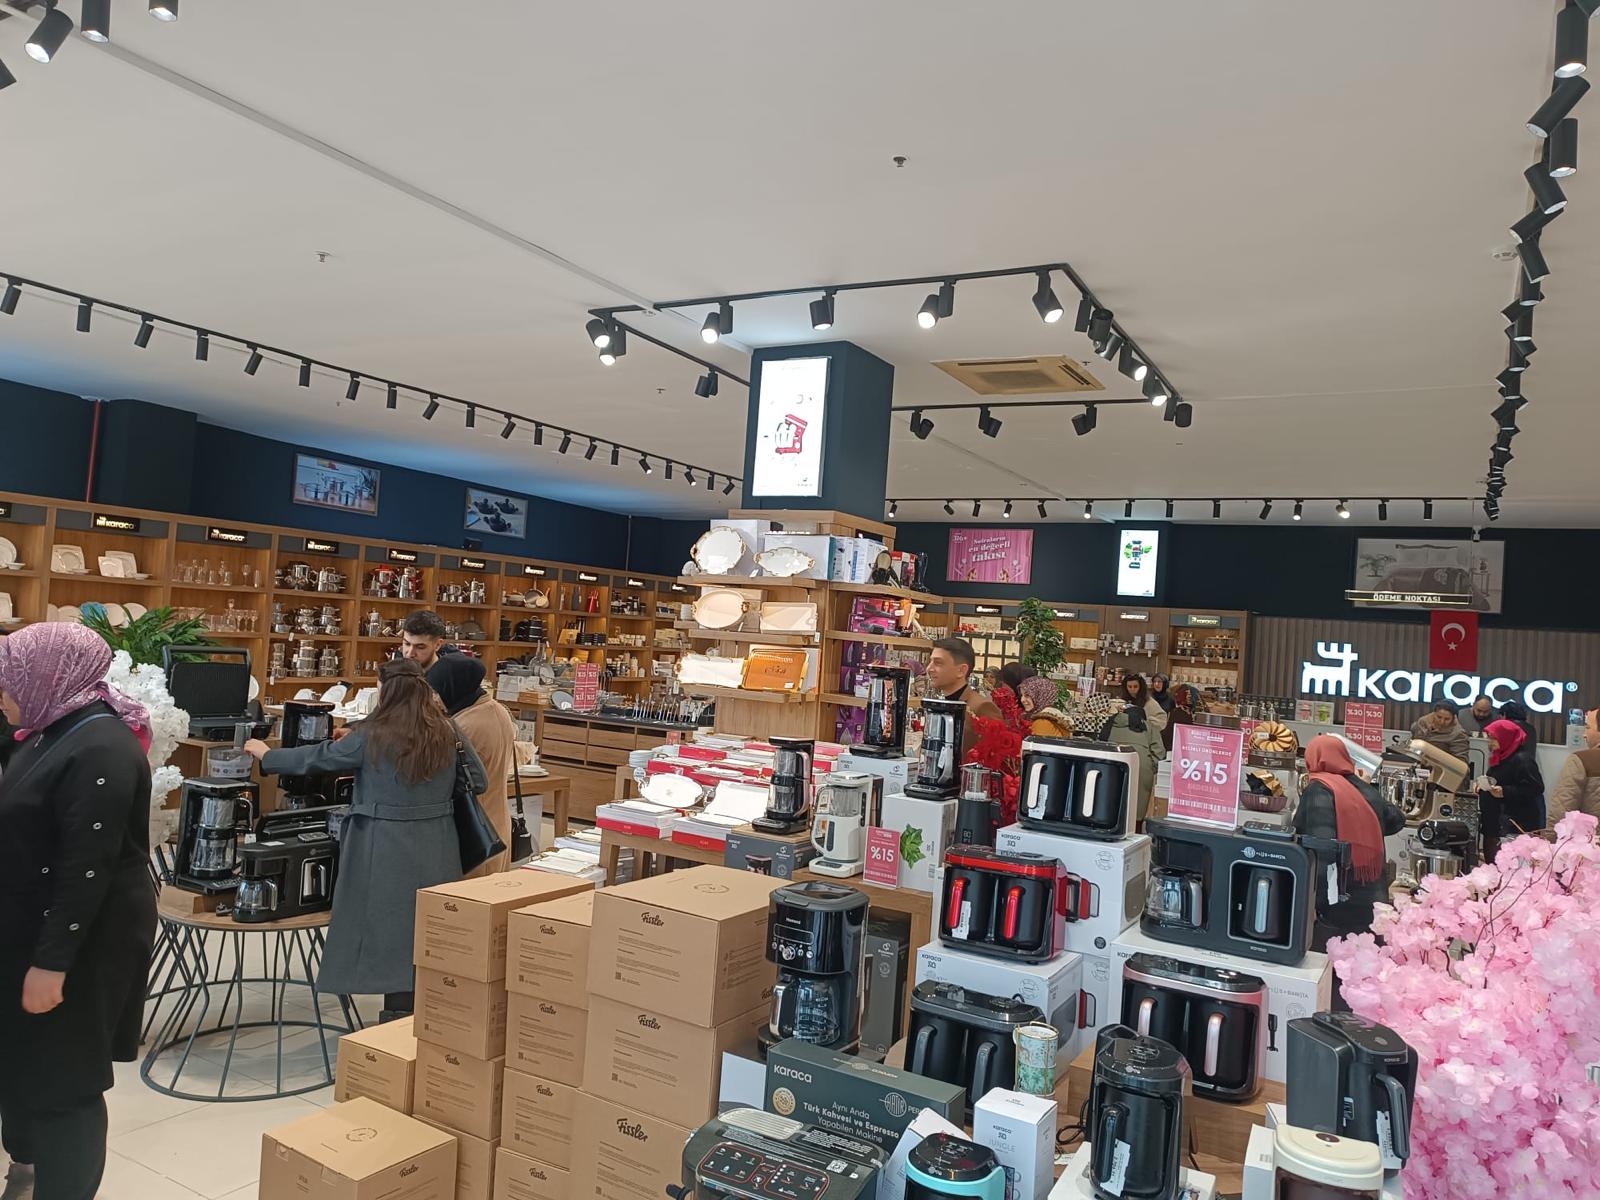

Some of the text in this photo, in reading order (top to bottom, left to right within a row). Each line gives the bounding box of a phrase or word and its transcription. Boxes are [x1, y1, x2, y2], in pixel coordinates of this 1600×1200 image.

[1373, 593, 1401, 601] ÖDEME
[1357, 668, 1563, 714] karaca
[1180, 758, 1228, 785] %15
[870, 846, 894, 862] %15
[641, 911, 664, 927] Fissler
[637, 1014, 661, 1030] Fissler
[773, 1064, 812, 1083] karaca
[803, 1102, 899, 1138] Türk Kahvesi ve Espresso
[849, 1106, 870, 1120] Anda
[617, 1118, 648, 1142] Fissler
[817, 1116, 883, 1143] Yapabilen Makine
